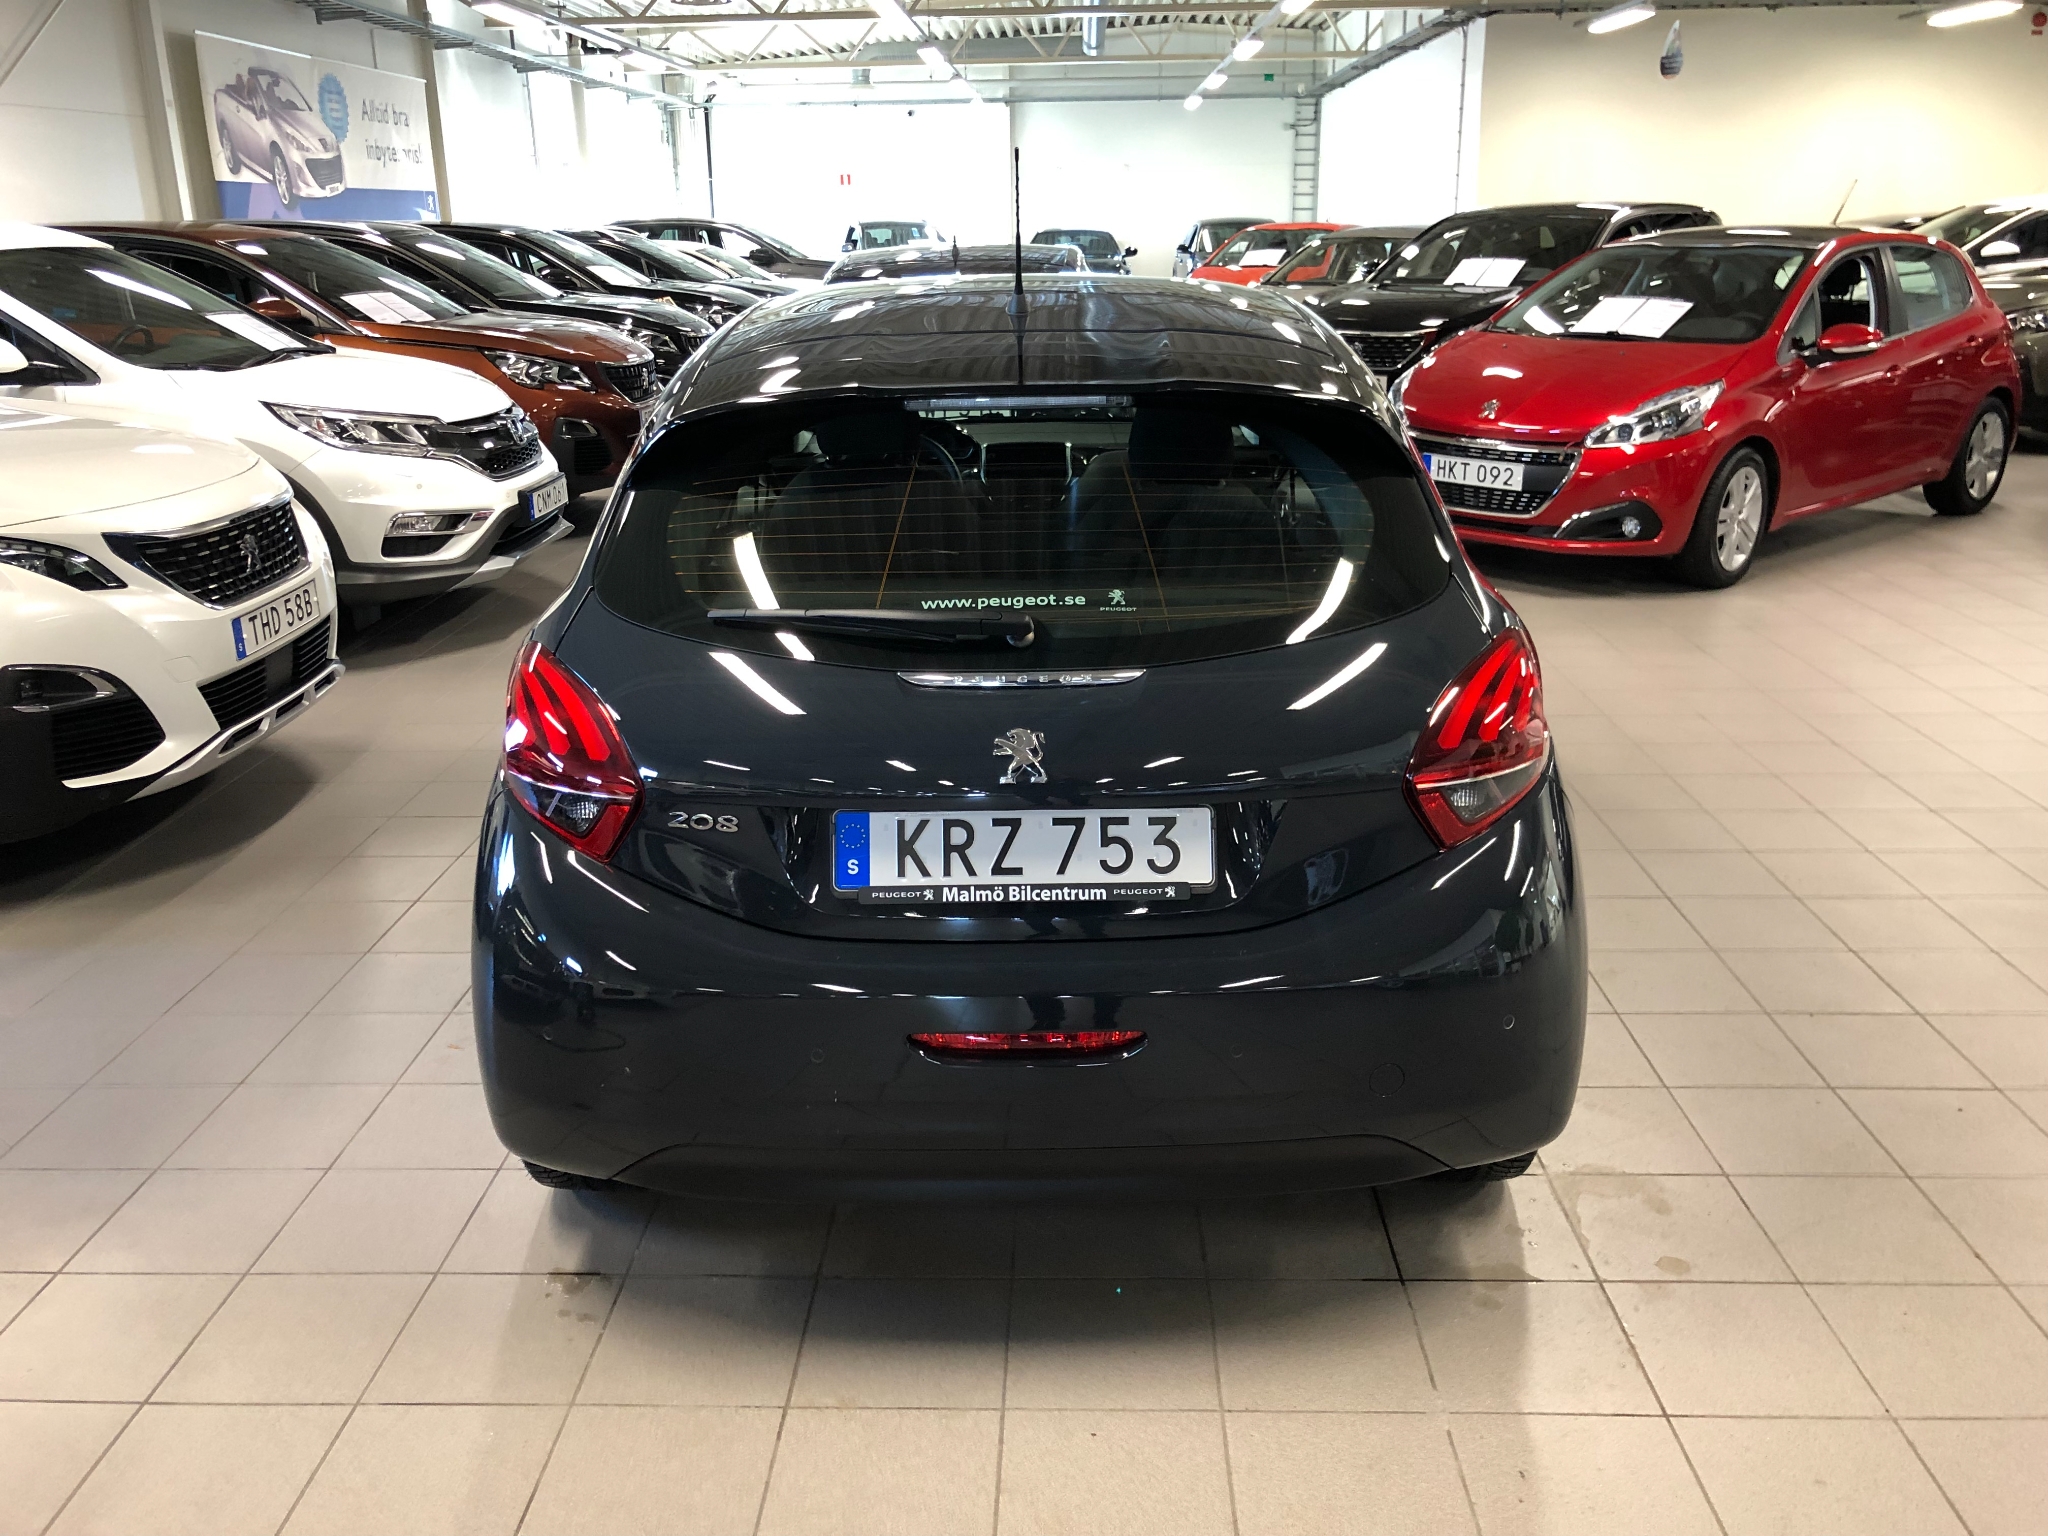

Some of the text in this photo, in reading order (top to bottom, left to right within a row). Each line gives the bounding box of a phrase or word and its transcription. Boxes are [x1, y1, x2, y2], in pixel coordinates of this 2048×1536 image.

[391, 103, 410, 128] bra
[364, 138, 423, 169] inbyteris!
[1436, 459, 1514, 487] HKT 092
[920, 593, 1087, 611] www.peugeot.se
[248, 588, 313, 646] THD 58B
[667, 811, 739, 833] 208
[896, 816, 1182, 878] KRZ 753
[846, 858, 860, 876] S
[871, 885, 1163, 903] PEUGEOT Malmö Bilcentrum PEUGEOT
